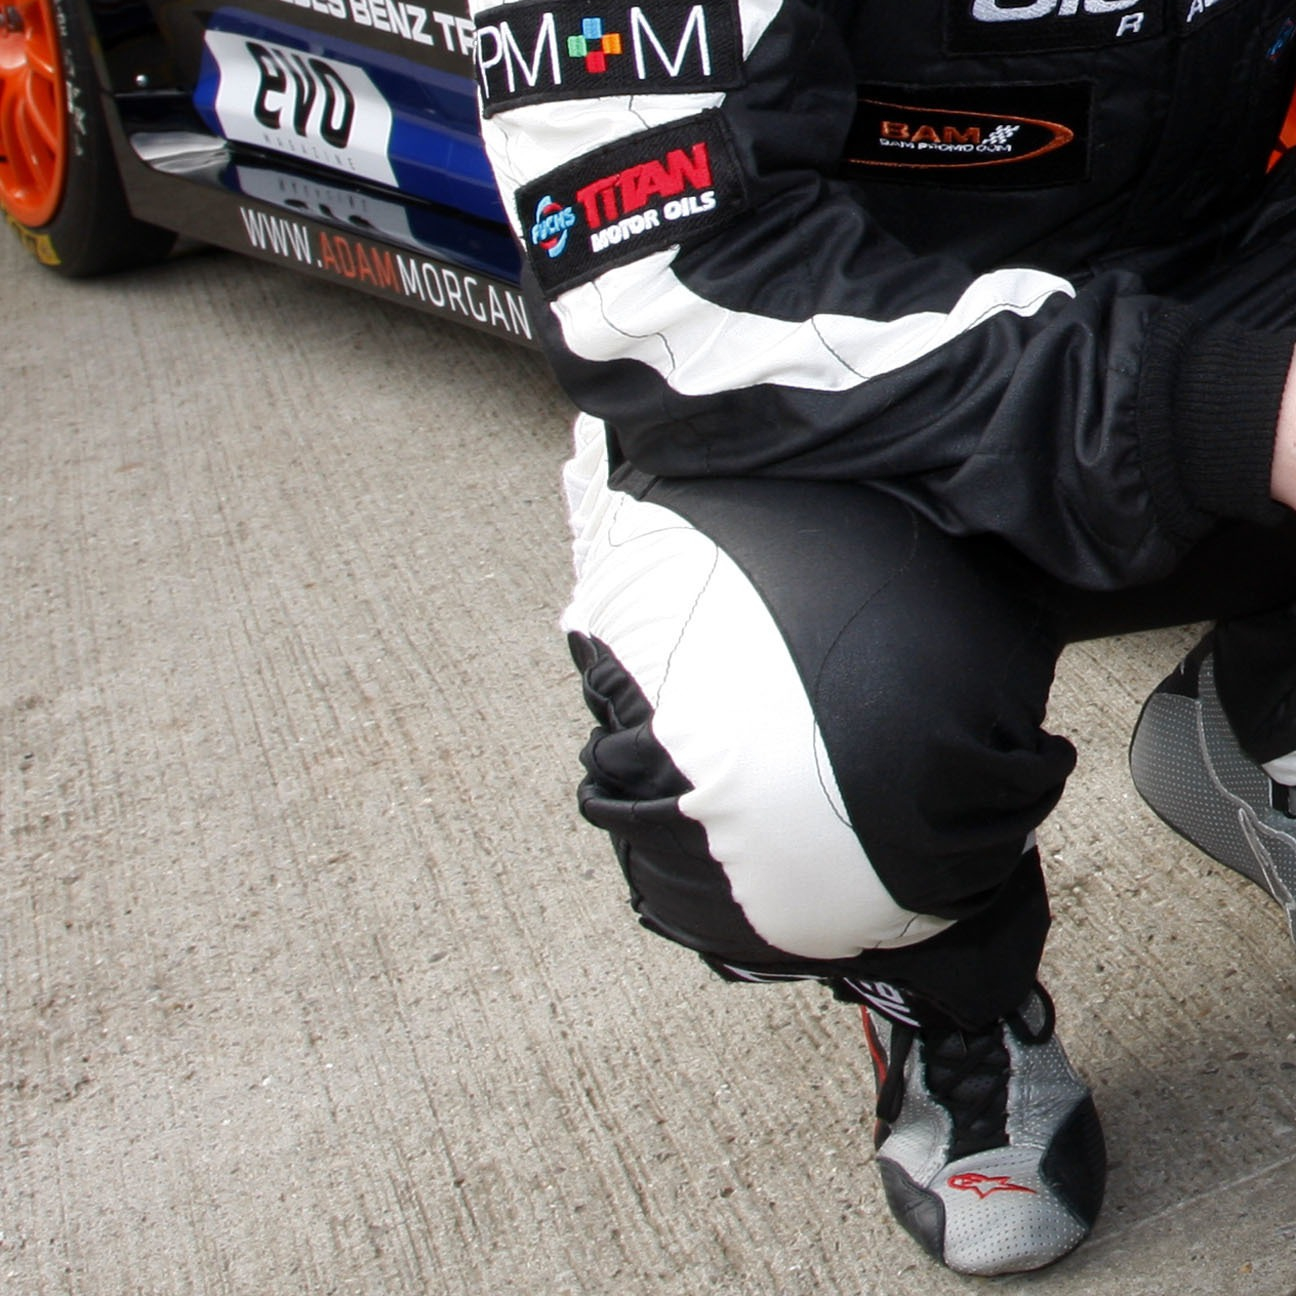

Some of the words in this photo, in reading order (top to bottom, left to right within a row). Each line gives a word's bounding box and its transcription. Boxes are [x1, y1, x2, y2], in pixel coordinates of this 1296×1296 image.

[881, 120, 981, 145] BAM
[531, 206, 577, 245] FUCHS
[591, 209, 660, 252] MOTOR
[663, 190, 716, 221] OILS
